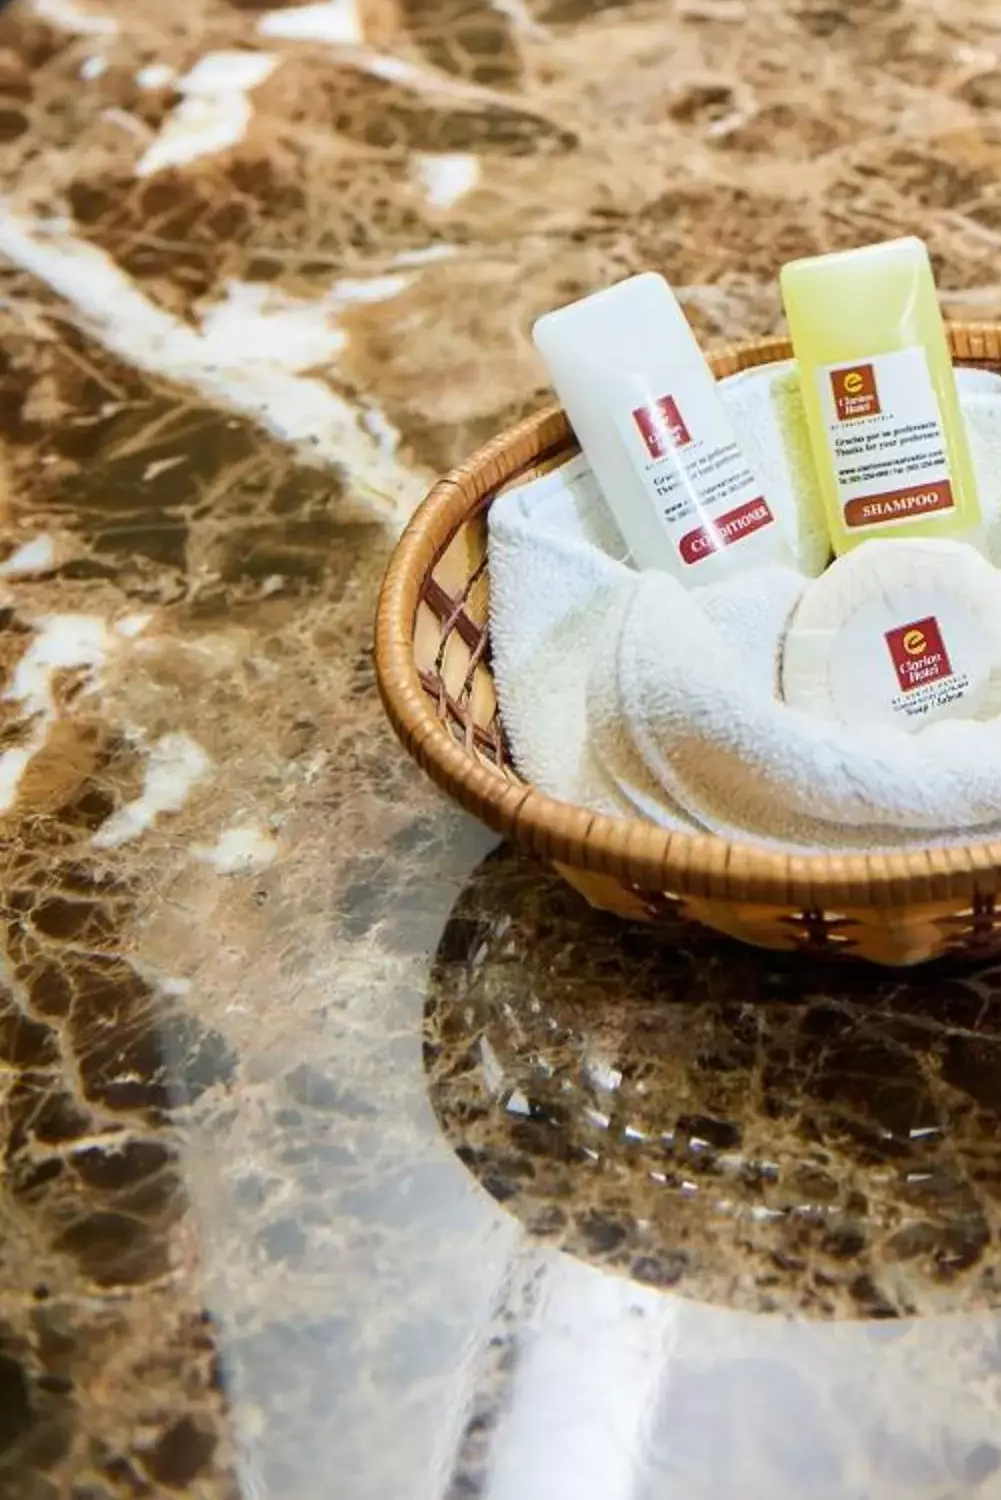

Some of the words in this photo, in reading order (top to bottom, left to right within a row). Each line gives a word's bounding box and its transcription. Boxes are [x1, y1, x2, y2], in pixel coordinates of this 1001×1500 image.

[835, 434, 865, 446] Gracias
[867, 432, 881, 443] por
[835, 443, 863, 457] Thanks
[866, 439, 878, 450] for
[879, 439, 897, 451] your
[900, 431, 939, 445] preference
[863, 491, 939, 517] SHAMPOO
[899, 653, 942, 674] Clarion
[909, 663, 939, 683] Hotel
